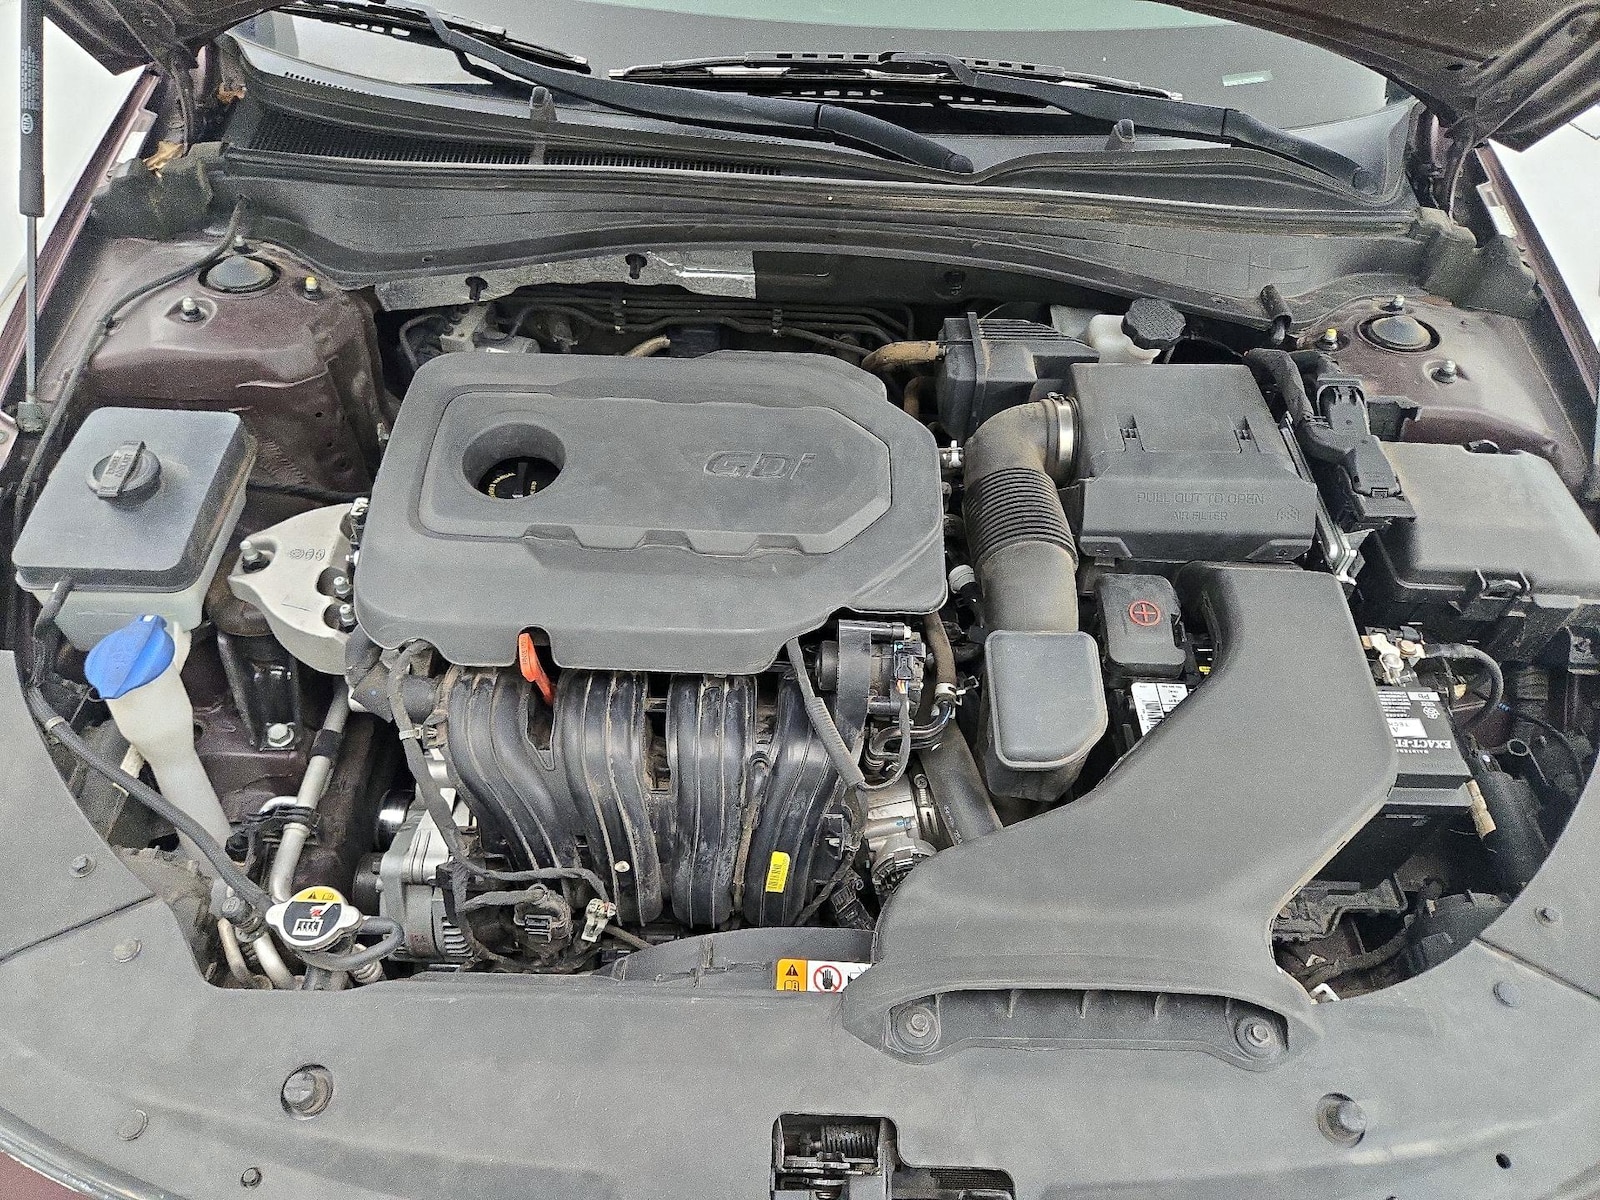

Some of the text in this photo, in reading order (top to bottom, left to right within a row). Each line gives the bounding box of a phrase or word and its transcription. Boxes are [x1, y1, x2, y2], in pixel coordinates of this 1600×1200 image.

[1136, 492, 1265, 505] PULL OUT TO OPEN
[1173, 511, 1229, 521] AIR FILTER
